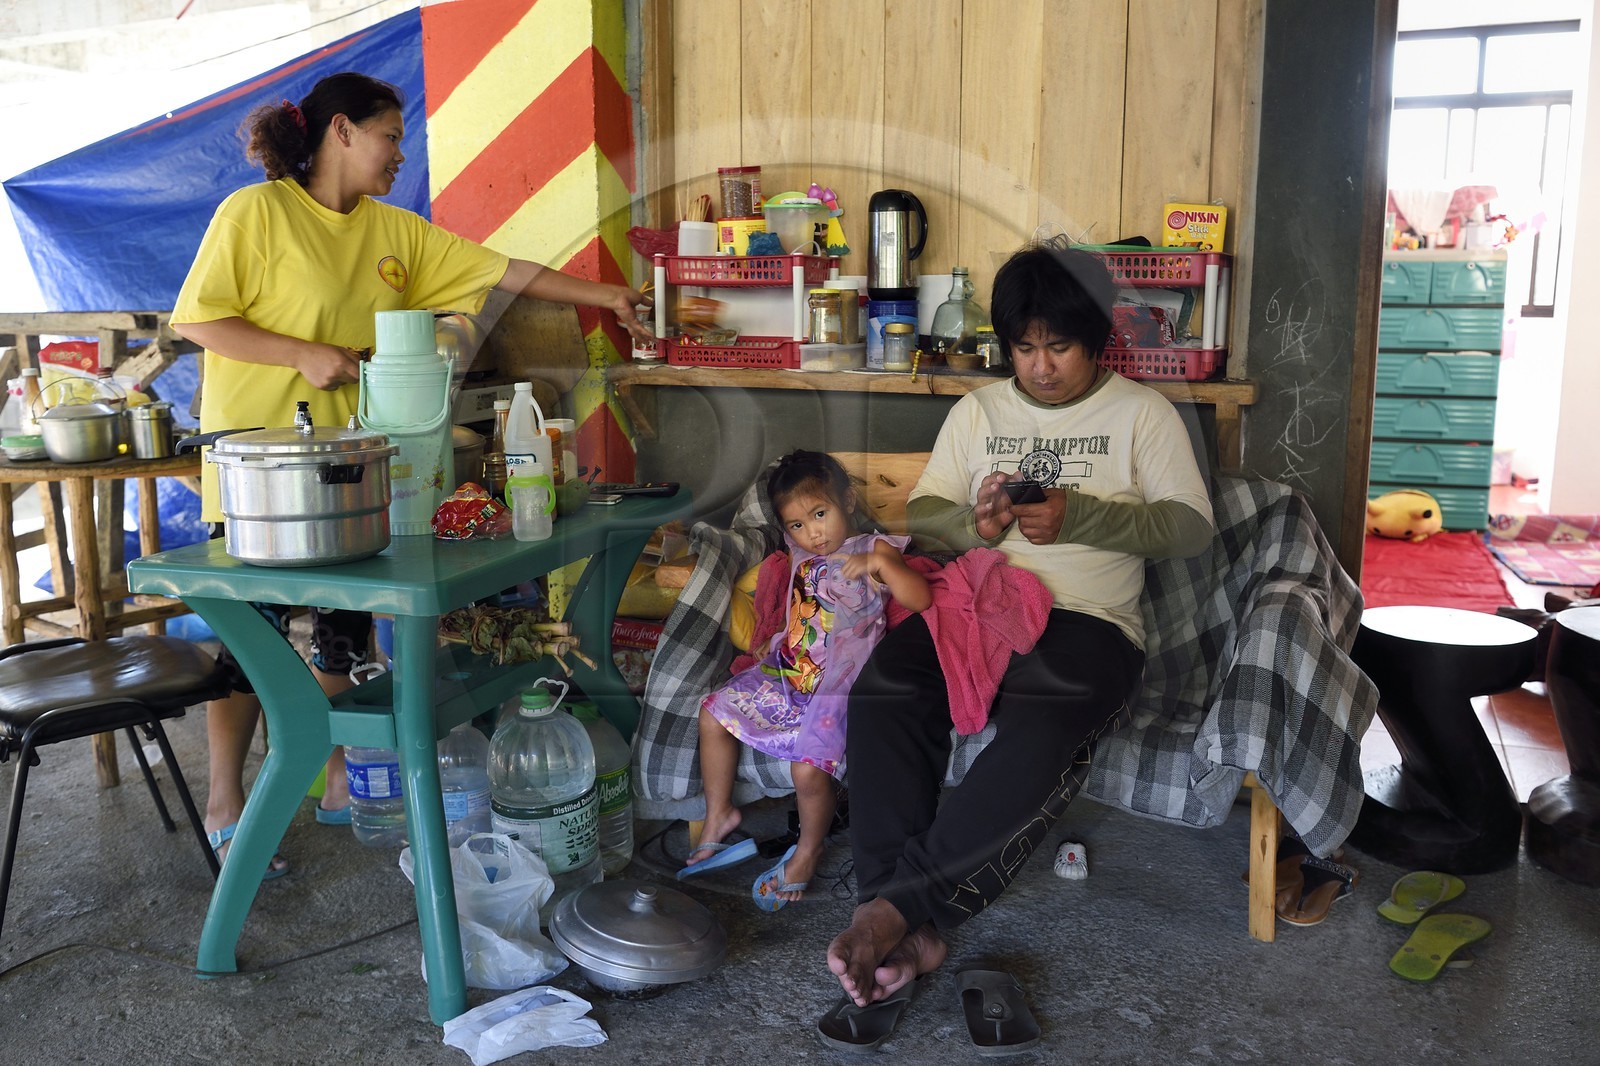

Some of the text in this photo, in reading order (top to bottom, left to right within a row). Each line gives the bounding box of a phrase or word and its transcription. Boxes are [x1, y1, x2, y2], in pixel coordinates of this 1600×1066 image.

[1185, 211, 1219, 224] NISSIN
[985, 435, 1110, 456] WEST HAMPTON
[552, 800, 581, 816] Distilled
